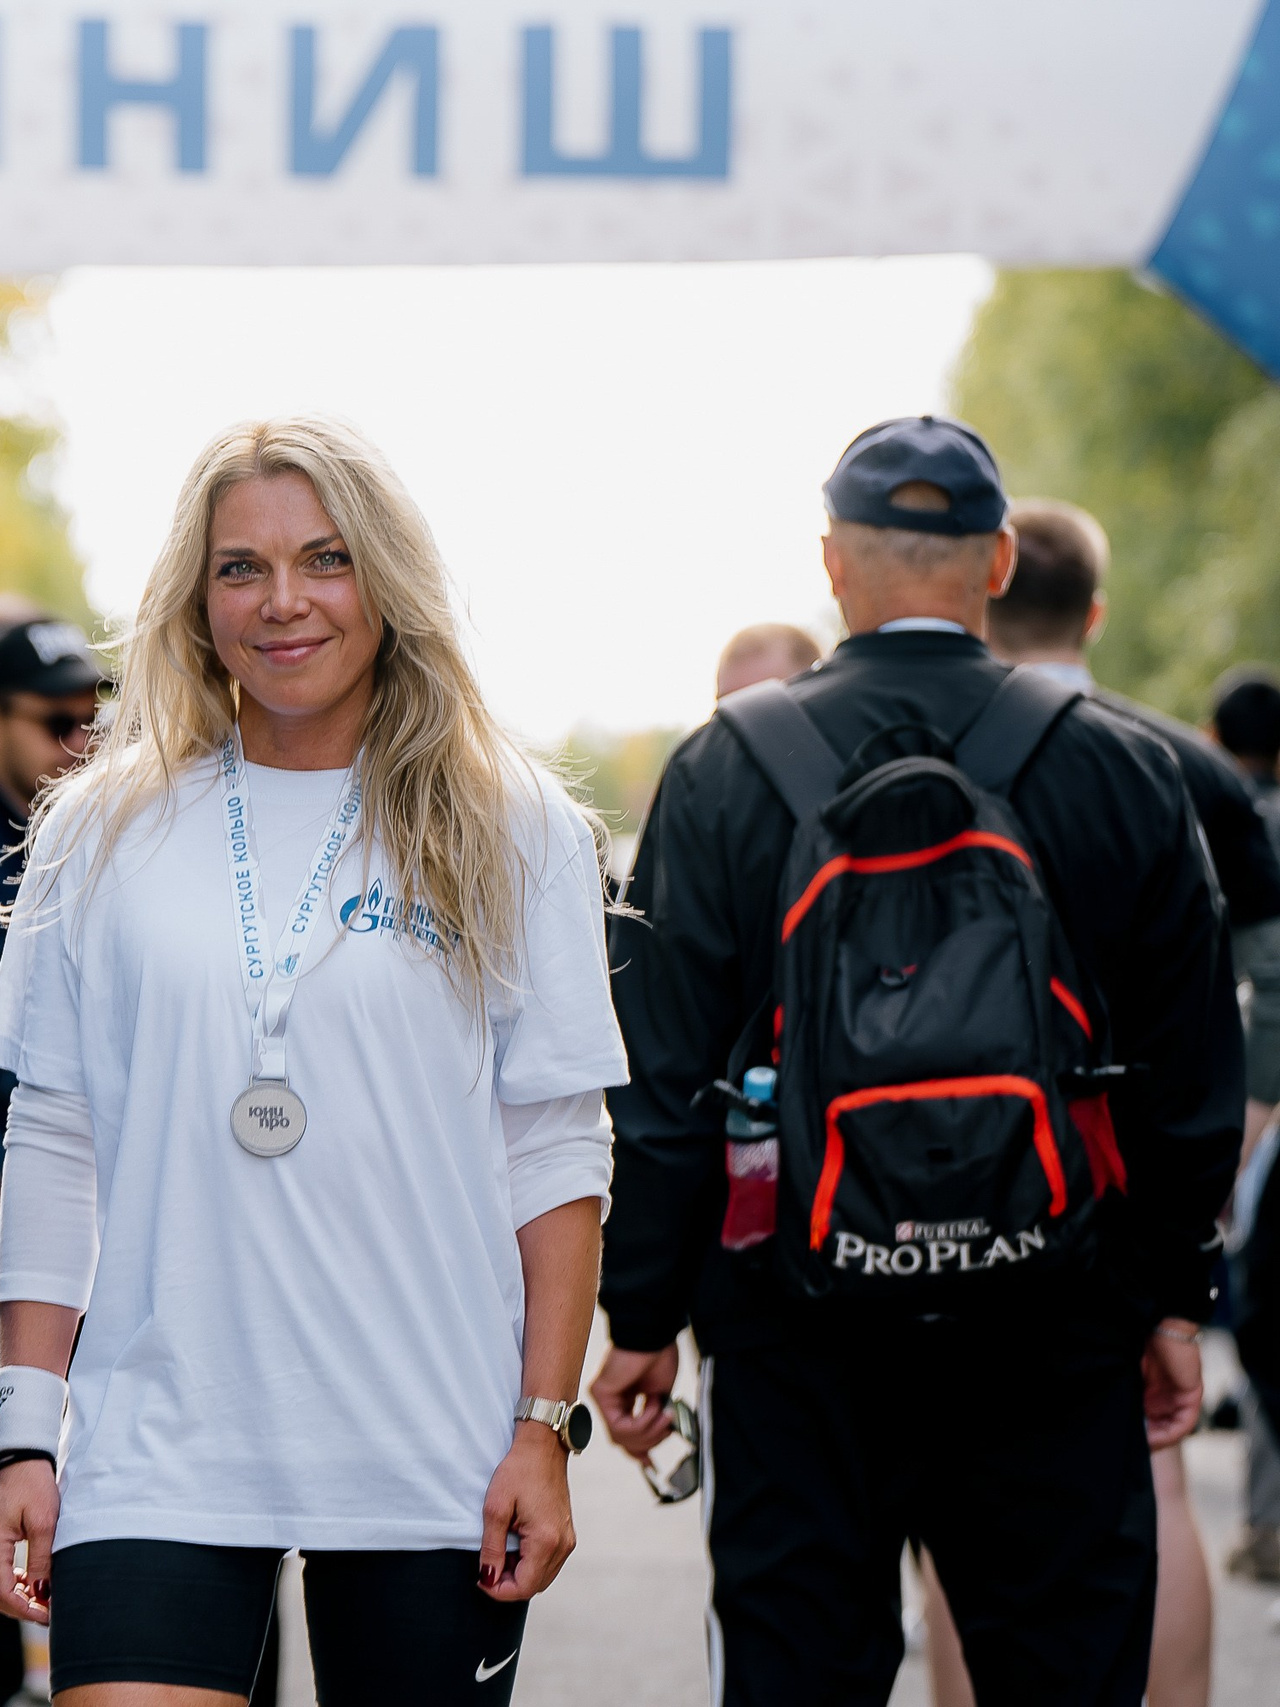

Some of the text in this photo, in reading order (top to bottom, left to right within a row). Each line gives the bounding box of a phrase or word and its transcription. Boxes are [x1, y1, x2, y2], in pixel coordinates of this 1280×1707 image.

[227, 796, 249, 864] КОЛЬЦО
[291, 830, 347, 934] СУРГУТСКОЕ
[235, 868, 265, 980] СУРГУТСКОЕ
